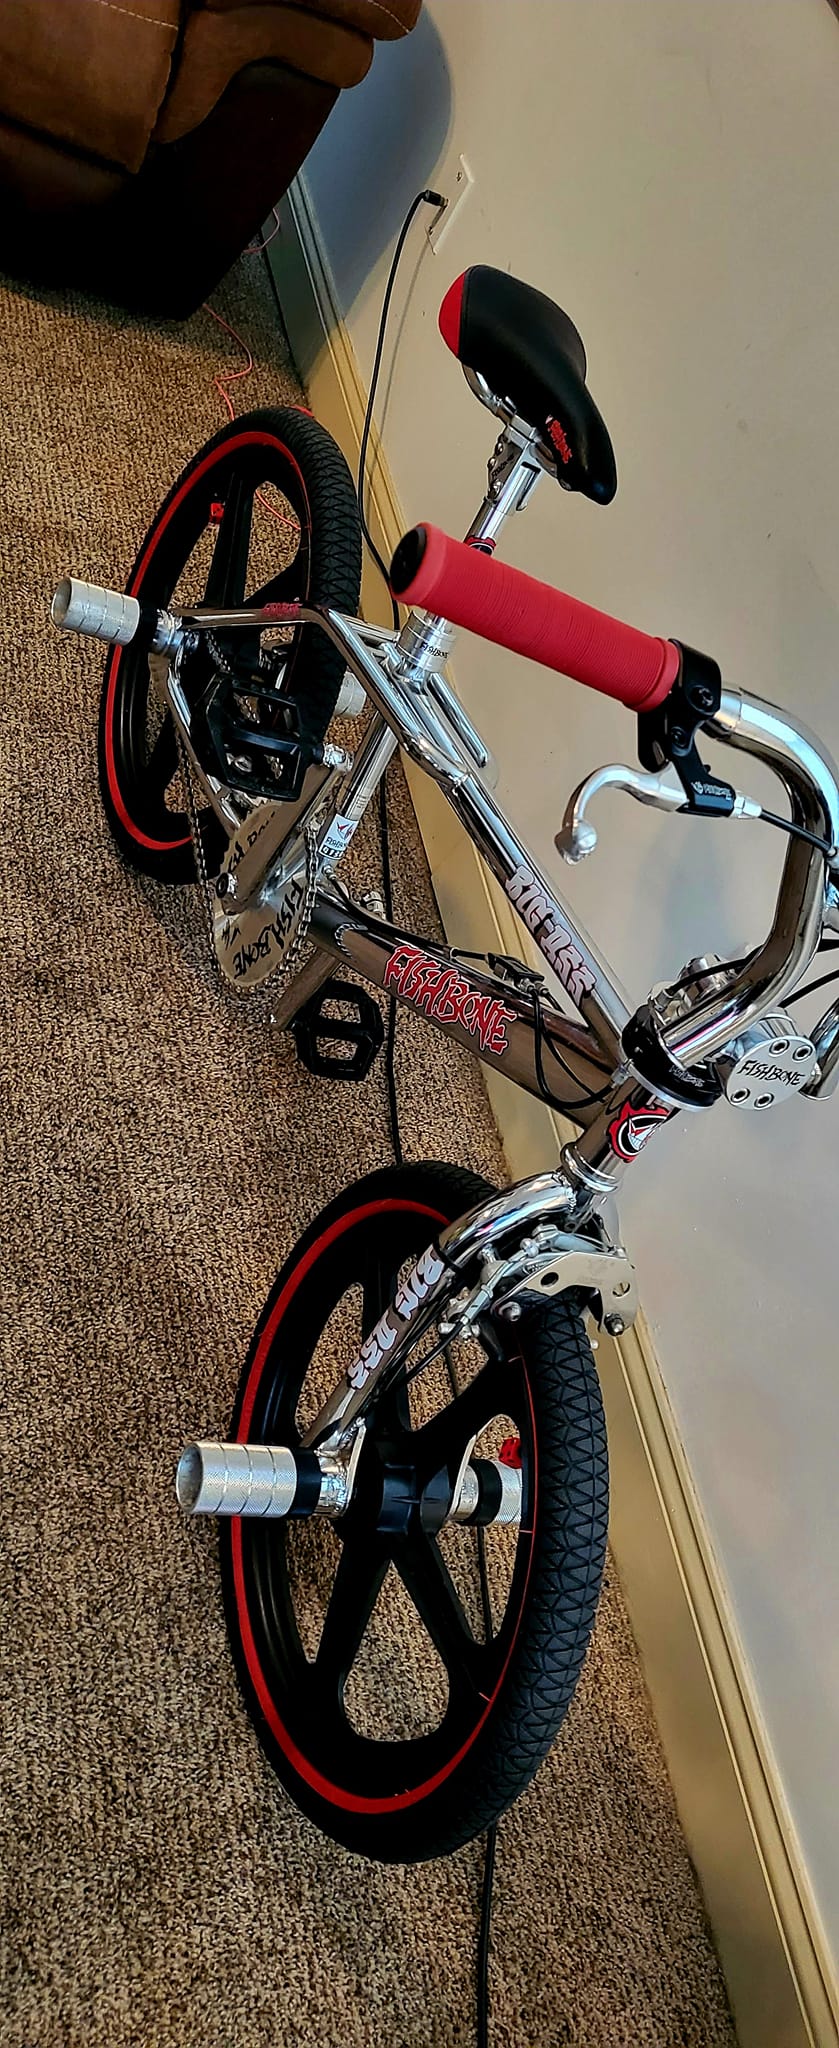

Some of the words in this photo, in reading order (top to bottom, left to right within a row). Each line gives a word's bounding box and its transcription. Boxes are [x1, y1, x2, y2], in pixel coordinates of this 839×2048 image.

[234, 878, 304, 979] FISHBONE
[384, 945, 517, 1056] FISHBONE
[736, 1060, 806, 1086] FISHBONE
[396, 1243, 445, 1321] BIG
